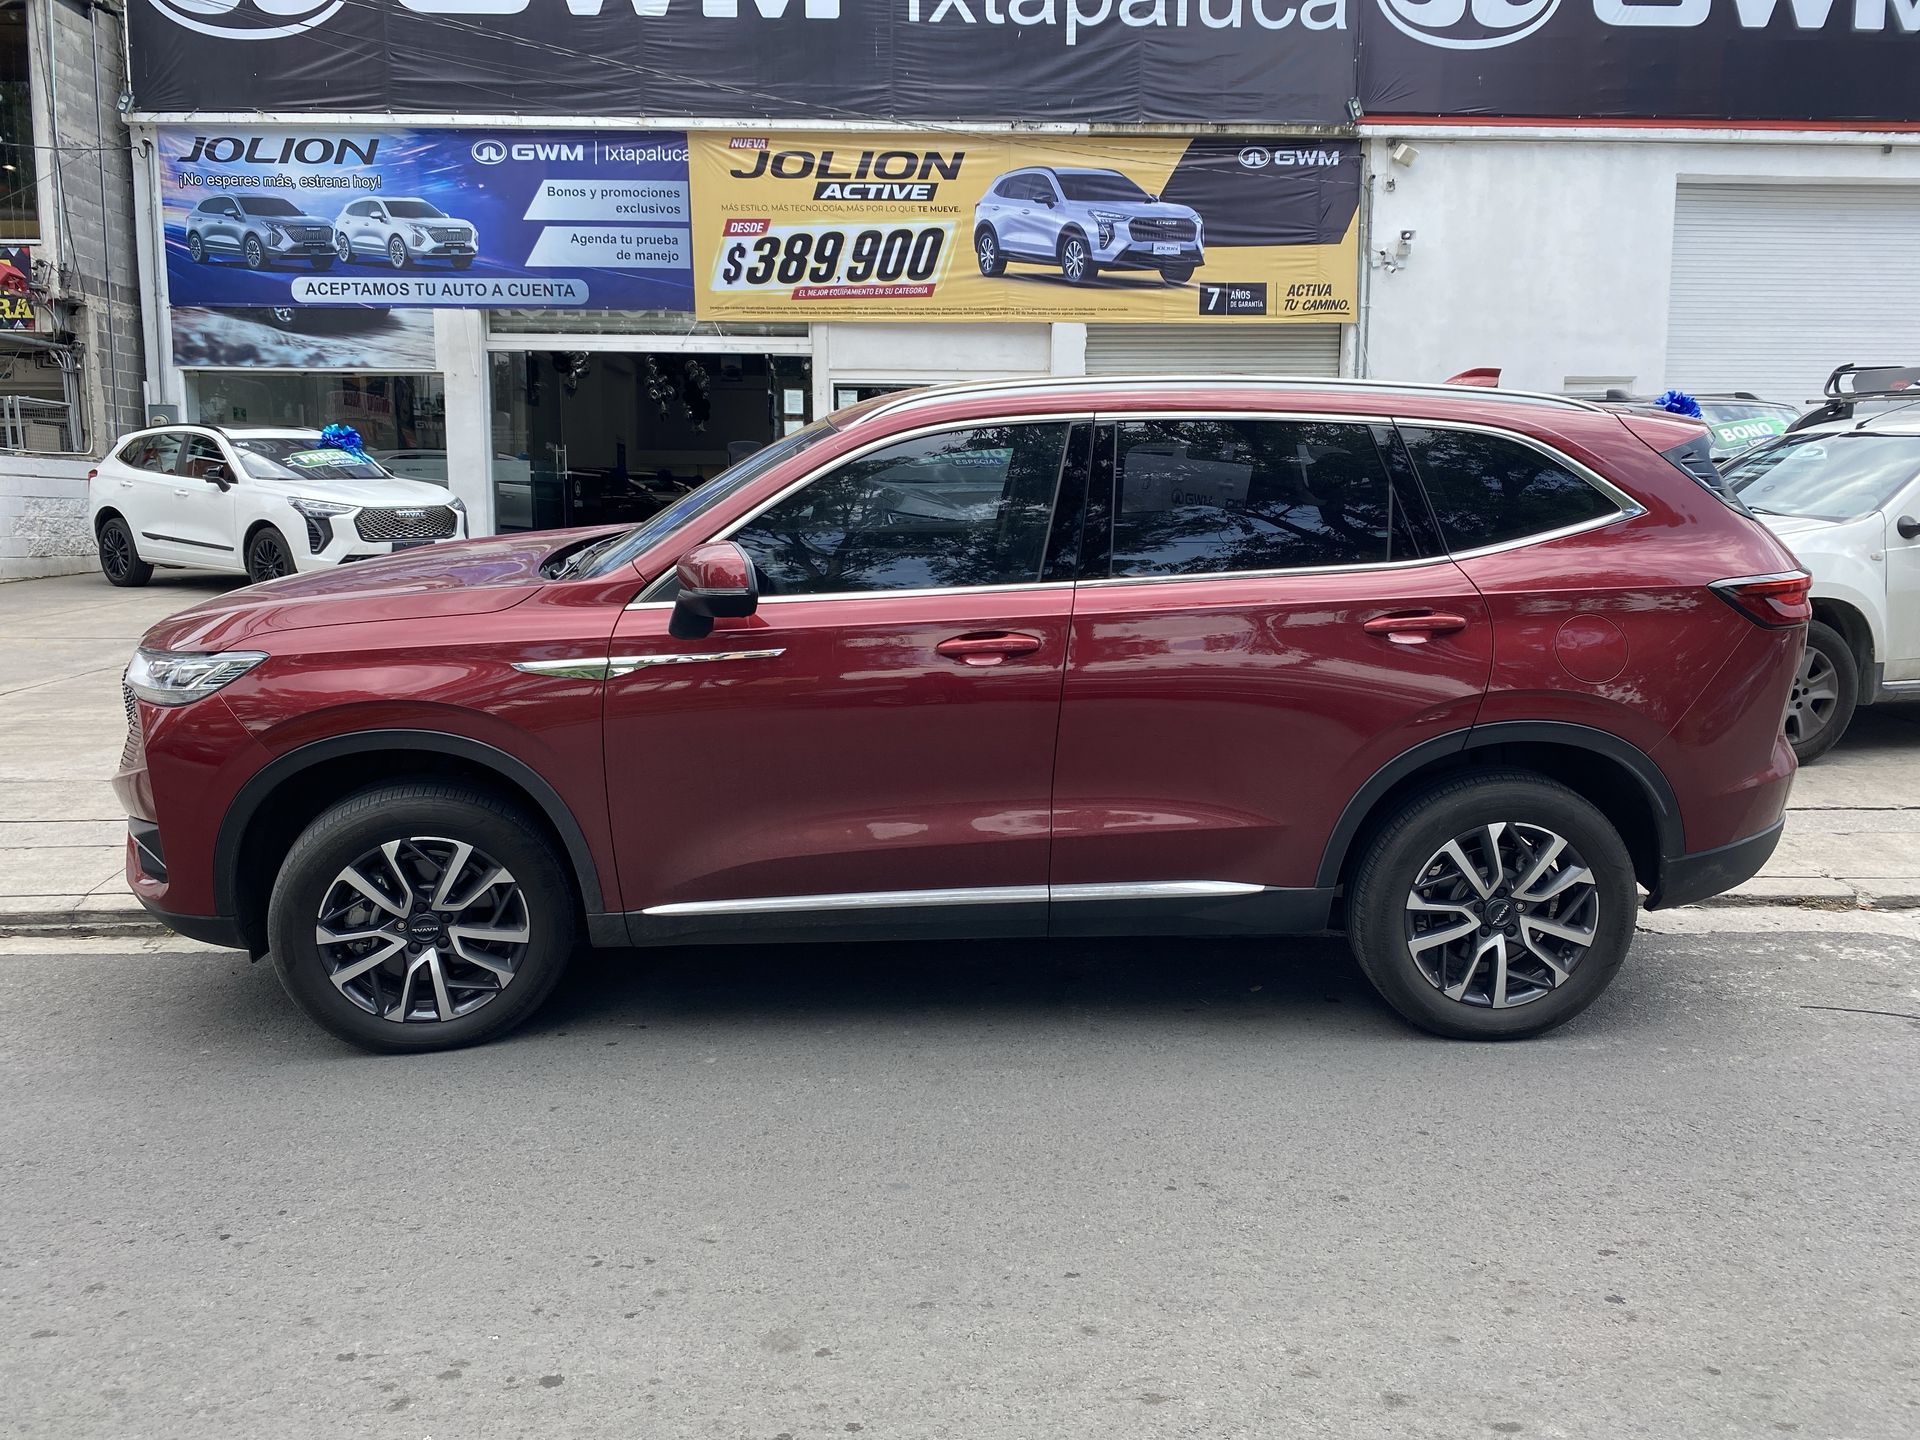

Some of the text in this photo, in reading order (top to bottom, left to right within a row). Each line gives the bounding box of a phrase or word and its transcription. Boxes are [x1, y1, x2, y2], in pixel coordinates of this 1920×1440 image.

[177, 136, 379, 165] JOLION
[731, 138, 767, 149] NUEVA
[512, 144, 584, 161] GWM
[605, 145, 690, 164] Ixtapaluca
[1274, 150, 1340, 166] GWM
[730, 150, 966, 181] JOLION
[206, 175, 260, 189] esperes
[263, 173, 296, 189] más,
[300, 174, 350, 188] estrena
[352, 175, 382, 191] hoy!
[547, 186, 681, 200] Bonos y promociones
[820, 184, 932, 200] ACTIVE
[615, 203, 681, 215] exclusivos
[721, 204, 739, 212] MÁS
[772, 204, 789, 212] MÁS
[846, 204, 864, 212] MÁS
[867, 205, 883, 213] POR
[885, 205, 897, 213] LO
[898, 205, 916, 213] QUE
[918, 205, 927, 213] TE
[929, 205, 961, 213] MUEVE.
[730, 222, 764, 233] DESDE
[571, 233, 679, 248] Agenda tu prueba
[616, 250, 680, 263] de manejo
[723, 227, 945, 285] $389,900
[305, 281, 576, 298] ACEPTAMOS TU AUTO A CUENTA
[807, 288, 828, 296] MEJOR
[829, 288, 874, 296] EQUIPAMIENTO
[876, 287, 883, 295] EN
[884, 287, 893, 295] SU
[1230, 289, 1250, 300] AÑOS
[1287, 283, 1332, 297] ACTIVA
[1207, 287, 1220, 310] 7
[1284, 299, 1350, 310] TU CAMINO.
[1718, 421, 1774, 443] BONO
[955, 458, 1001, 466] ESPECIAL
